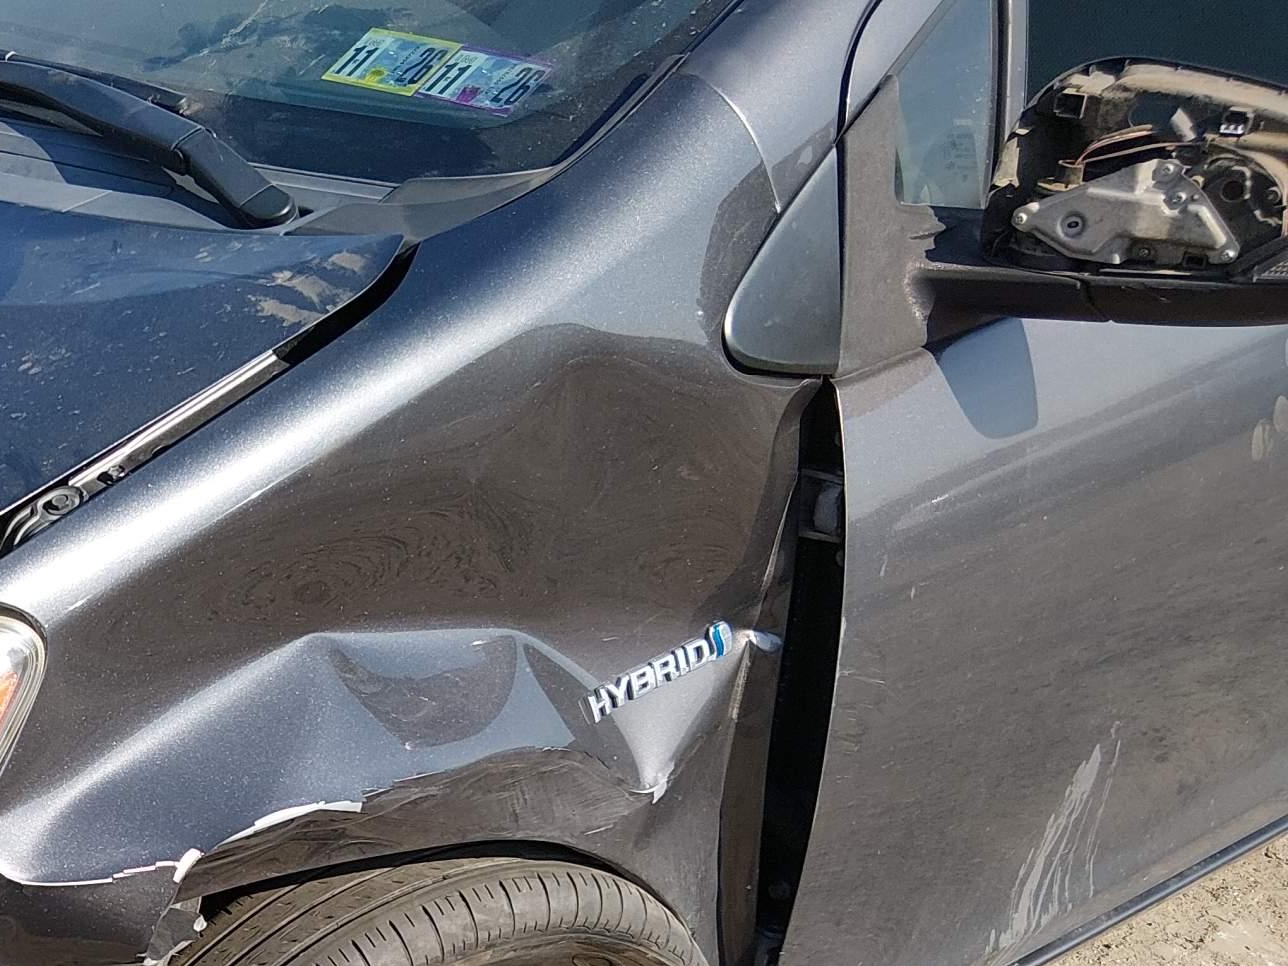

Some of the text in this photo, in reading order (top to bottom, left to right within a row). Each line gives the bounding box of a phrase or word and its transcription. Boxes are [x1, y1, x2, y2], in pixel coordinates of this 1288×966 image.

[335, 45, 379, 77] 11
[425, 62, 472, 96] 11
[489, 66, 546, 105] 26
[587, 637, 715, 724] HYBRID
